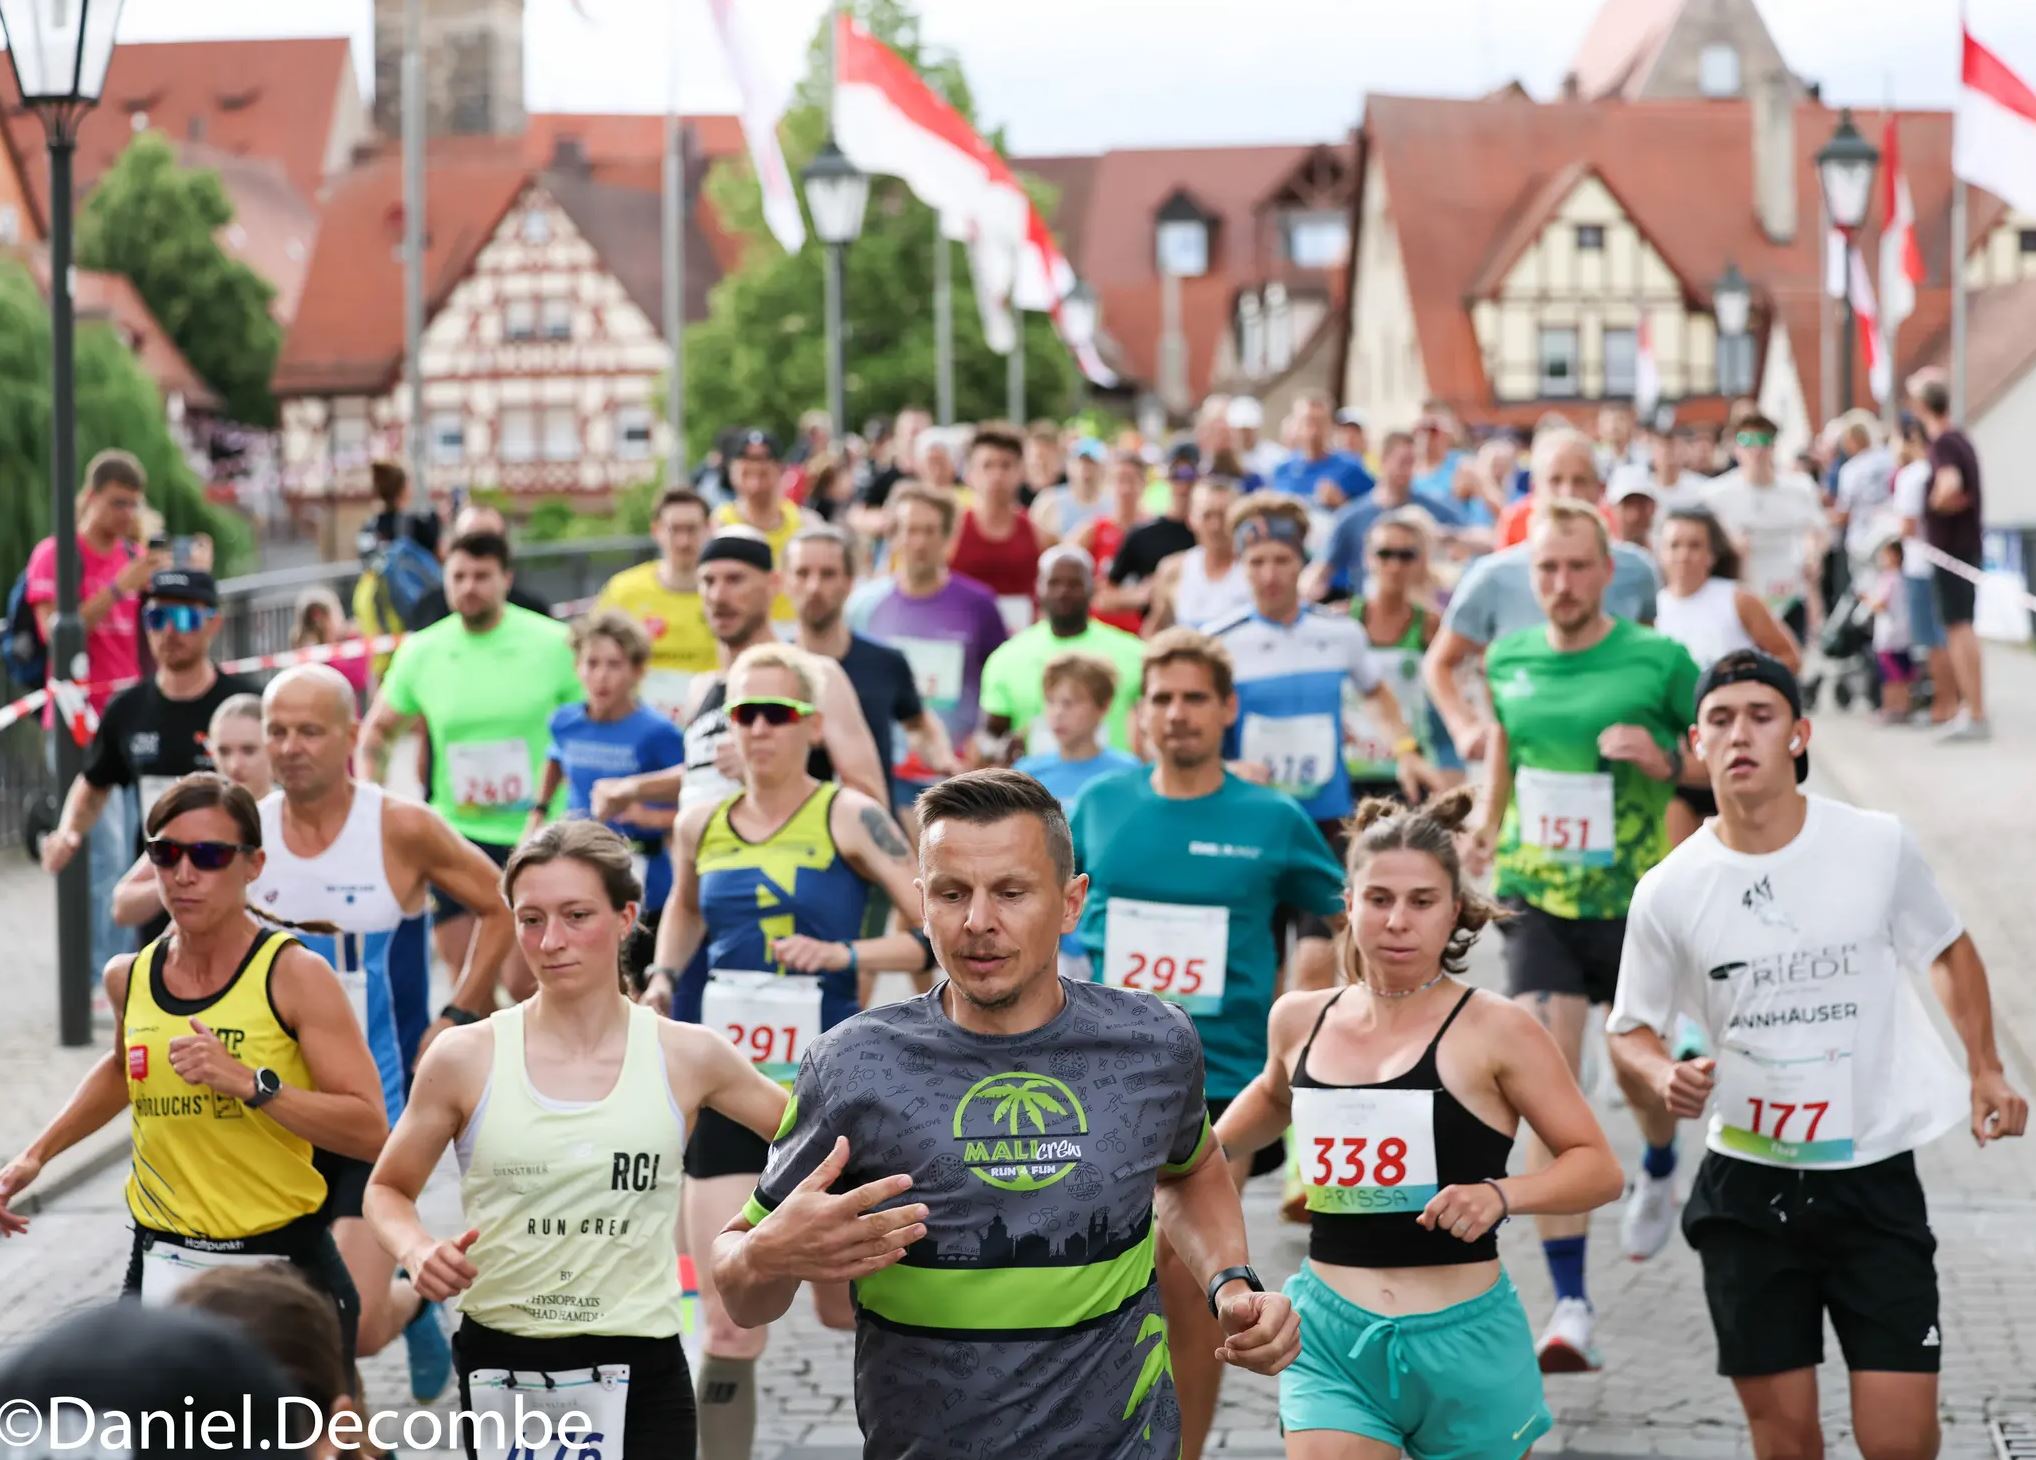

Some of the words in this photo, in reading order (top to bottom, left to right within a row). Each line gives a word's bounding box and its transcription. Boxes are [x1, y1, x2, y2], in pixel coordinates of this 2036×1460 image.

[1540, 816, 1589, 850] 151
[1122, 953, 1206, 995] 295
[1753, 957, 1859, 988] RIEDL
[1748, 1098, 1829, 1143] 177
[991, 1166, 1016, 1176] RUN
[1031, 1165, 1056, 1174] FUN
[1313, 1137, 1407, 1187] 338
[528, 1218, 566, 1235] RUN
[560, 1271, 573, 1281] BY
